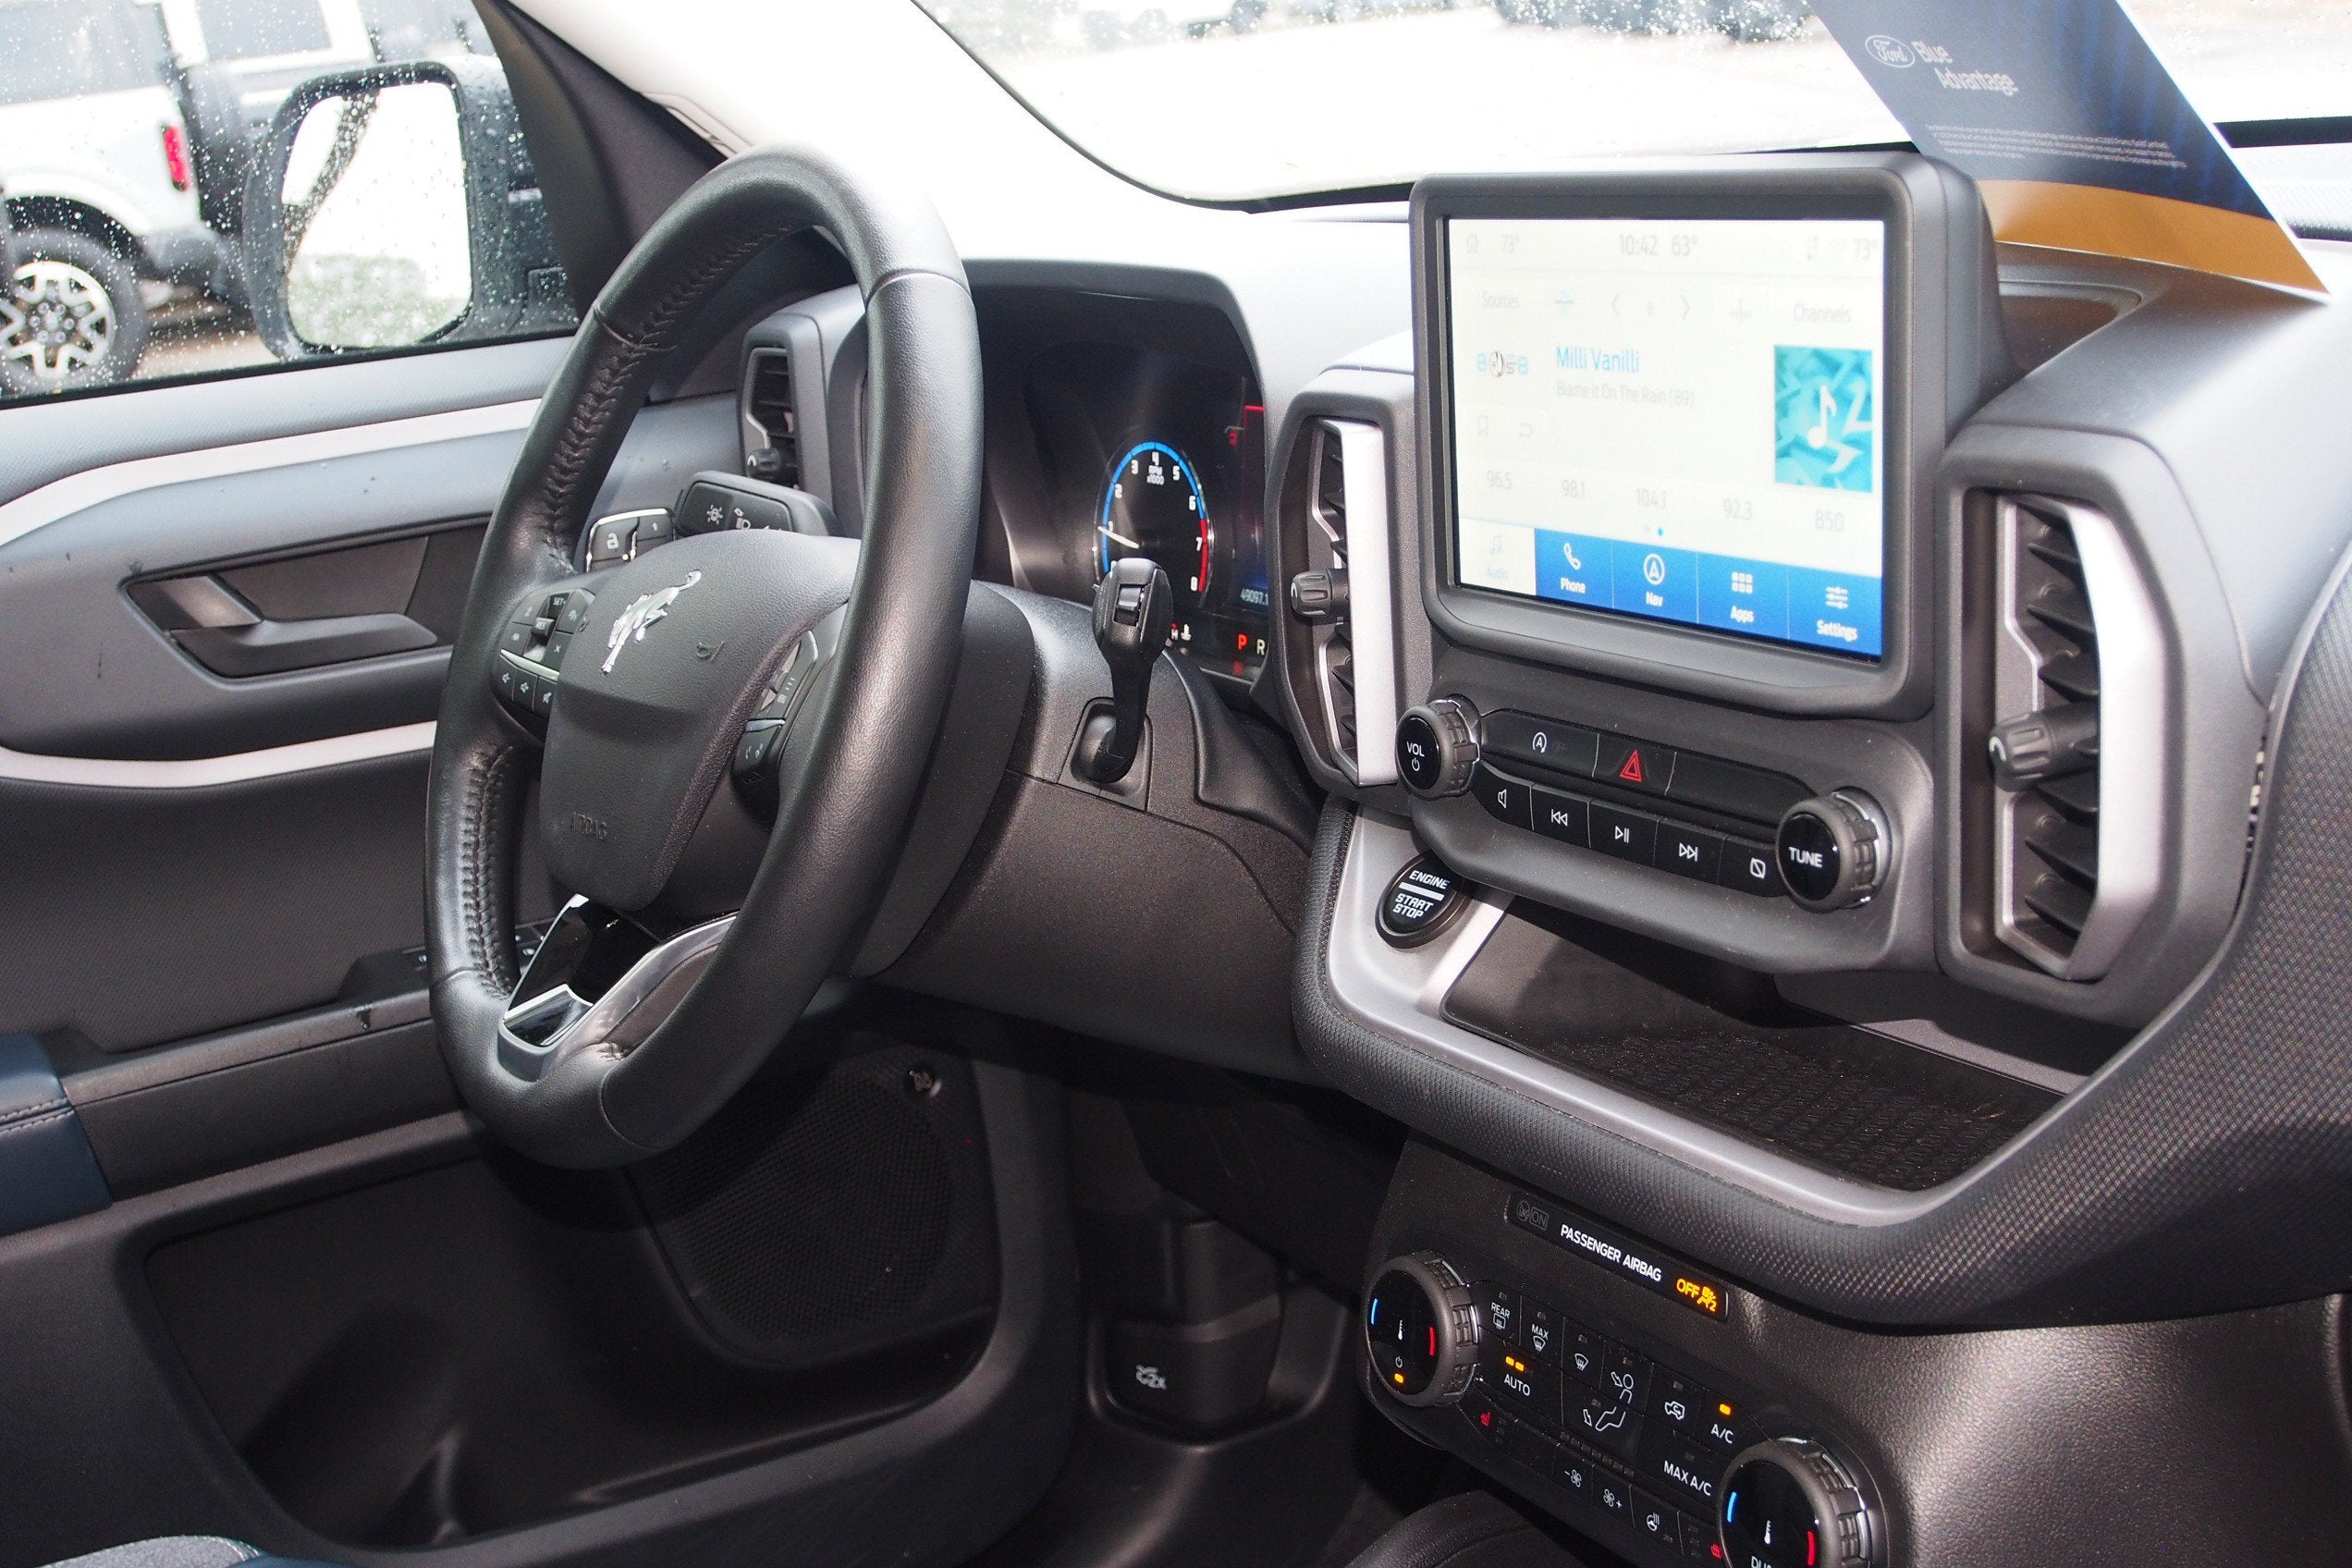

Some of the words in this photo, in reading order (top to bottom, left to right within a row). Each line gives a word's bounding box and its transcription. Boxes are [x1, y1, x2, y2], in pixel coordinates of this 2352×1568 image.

[1911, 40, 1954, 64] Blue
[1933, 67, 2019, 96] Advantage
[1620, 234, 1659, 256] 10:42
[1481, 291, 1520, 310] Sources
[1793, 303, 1853, 324] Channels
[1556, 345, 1587, 370] Milli
[1589, 348, 1640, 374] Vanilli
[1557, 380, 1589, 398] Blame
[1592, 383, 1601, 399] It
[1602, 383, 1617, 400] On
[1620, 384, 1640, 403] The
[1641, 386, 1666, 405] Rain
[1669, 387, 1695, 410] (89)
[1487, 470, 1513, 491] 96.5
[1561, 479, 1586, 499] 98.1
[1635, 488, 1667, 509] 104.1
[1723, 498, 1753, 521] 92.3
[1814, 508, 1844, 533] 850
[1485, 565, 1510, 582] Audio
[1560, 577, 1586, 594] Phone
[1646, 591, 1663, 606] Nav
[1730, 605, 1755, 624] Apps
[1816, 619, 1858, 642] Settings
[1237, 633, 1248, 650] P
[1256, 638, 1266, 655] R
[1406, 741, 1425, 757] VOL
[1788, 846, 1823, 869] TUNE
[1409, 869, 1451, 890] ENGINE
[1392, 903, 1426, 919] STOP
[1394, 892, 1434, 912] START
[1560, 1223, 1622, 1264] PASSENGER
[1623, 1254, 1662, 1282] AIRBAG
[1675, 1278, 1700, 1299] OFF
[1490, 1301, 1511, 1319] REAR
[1530, 1323, 1550, 1341] MAX
[1503, 1373, 1531, 1397] AUTO
[1710, 1423, 1734, 1444] A/C
[1663, 1460, 1689, 1486] MAX
[1690, 1475, 1712, 1497] A/C
